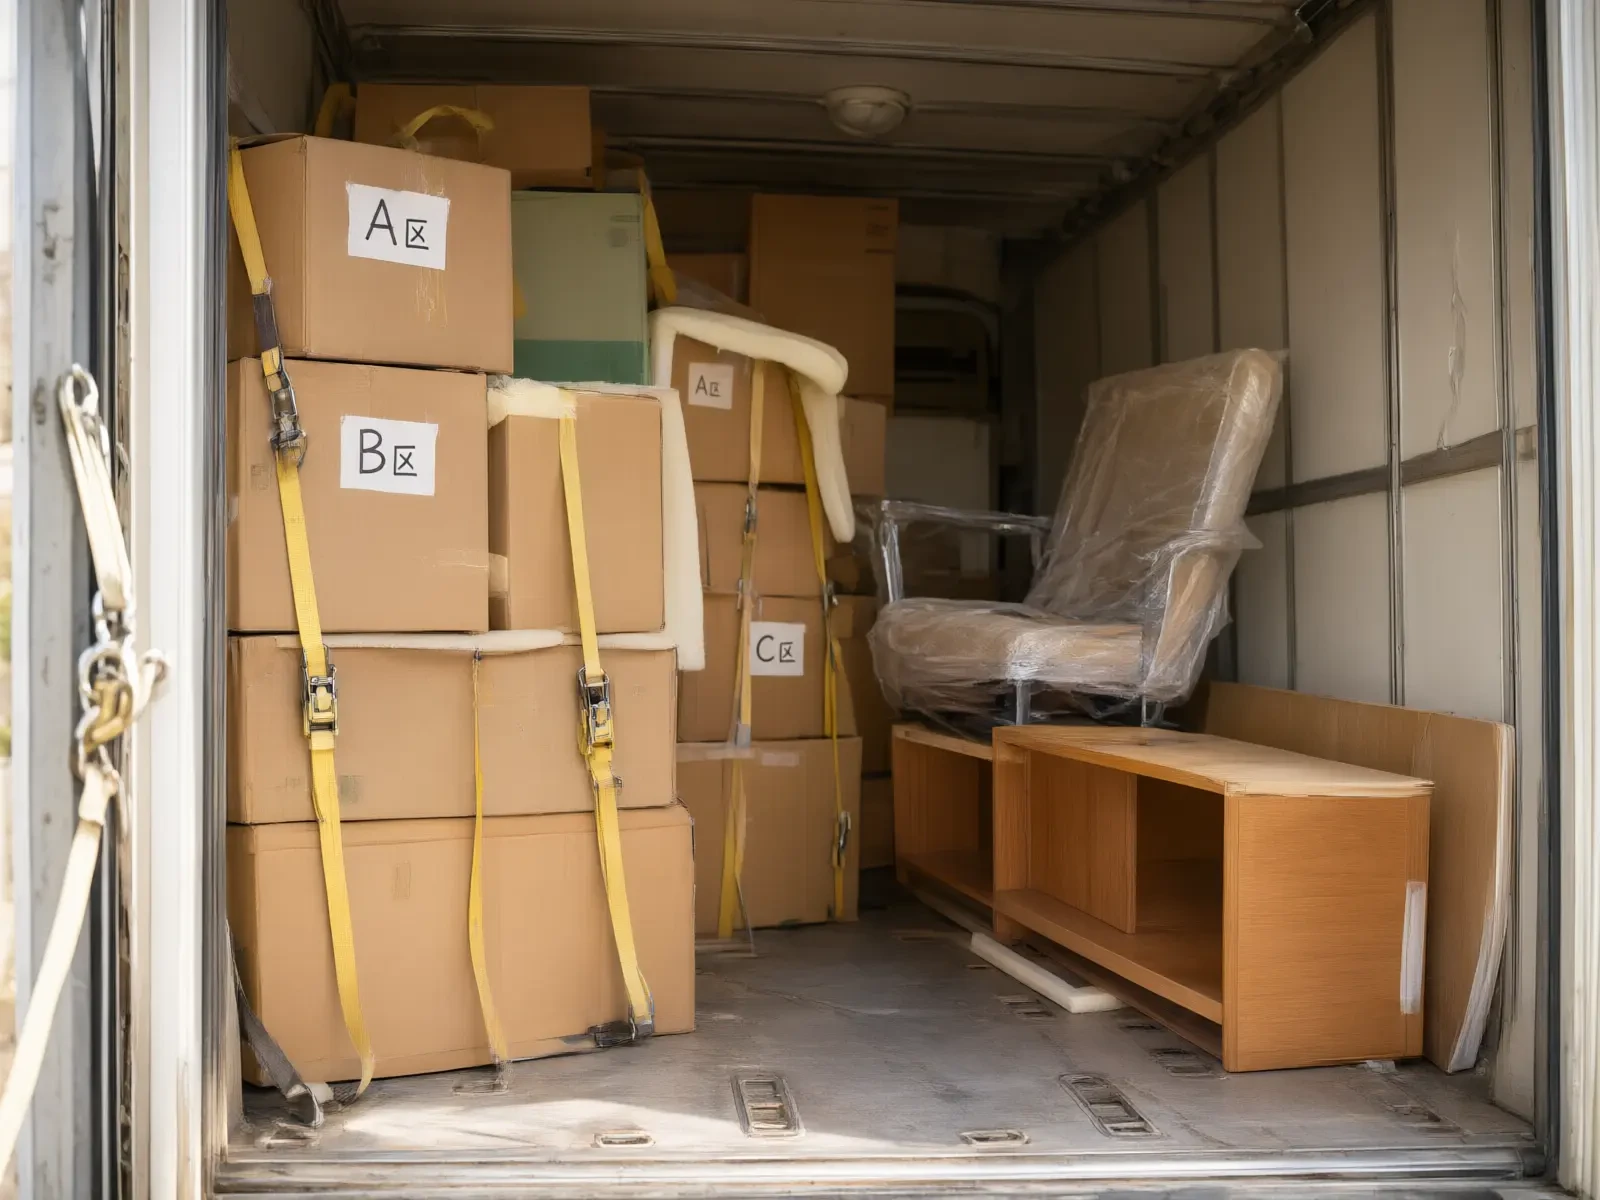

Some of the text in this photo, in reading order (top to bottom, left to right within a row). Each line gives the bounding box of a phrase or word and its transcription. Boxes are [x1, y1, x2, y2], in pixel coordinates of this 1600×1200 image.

[365, 198, 429, 250] A区
[359, 428, 418, 477] B区
[756, 634, 796, 663] C区
